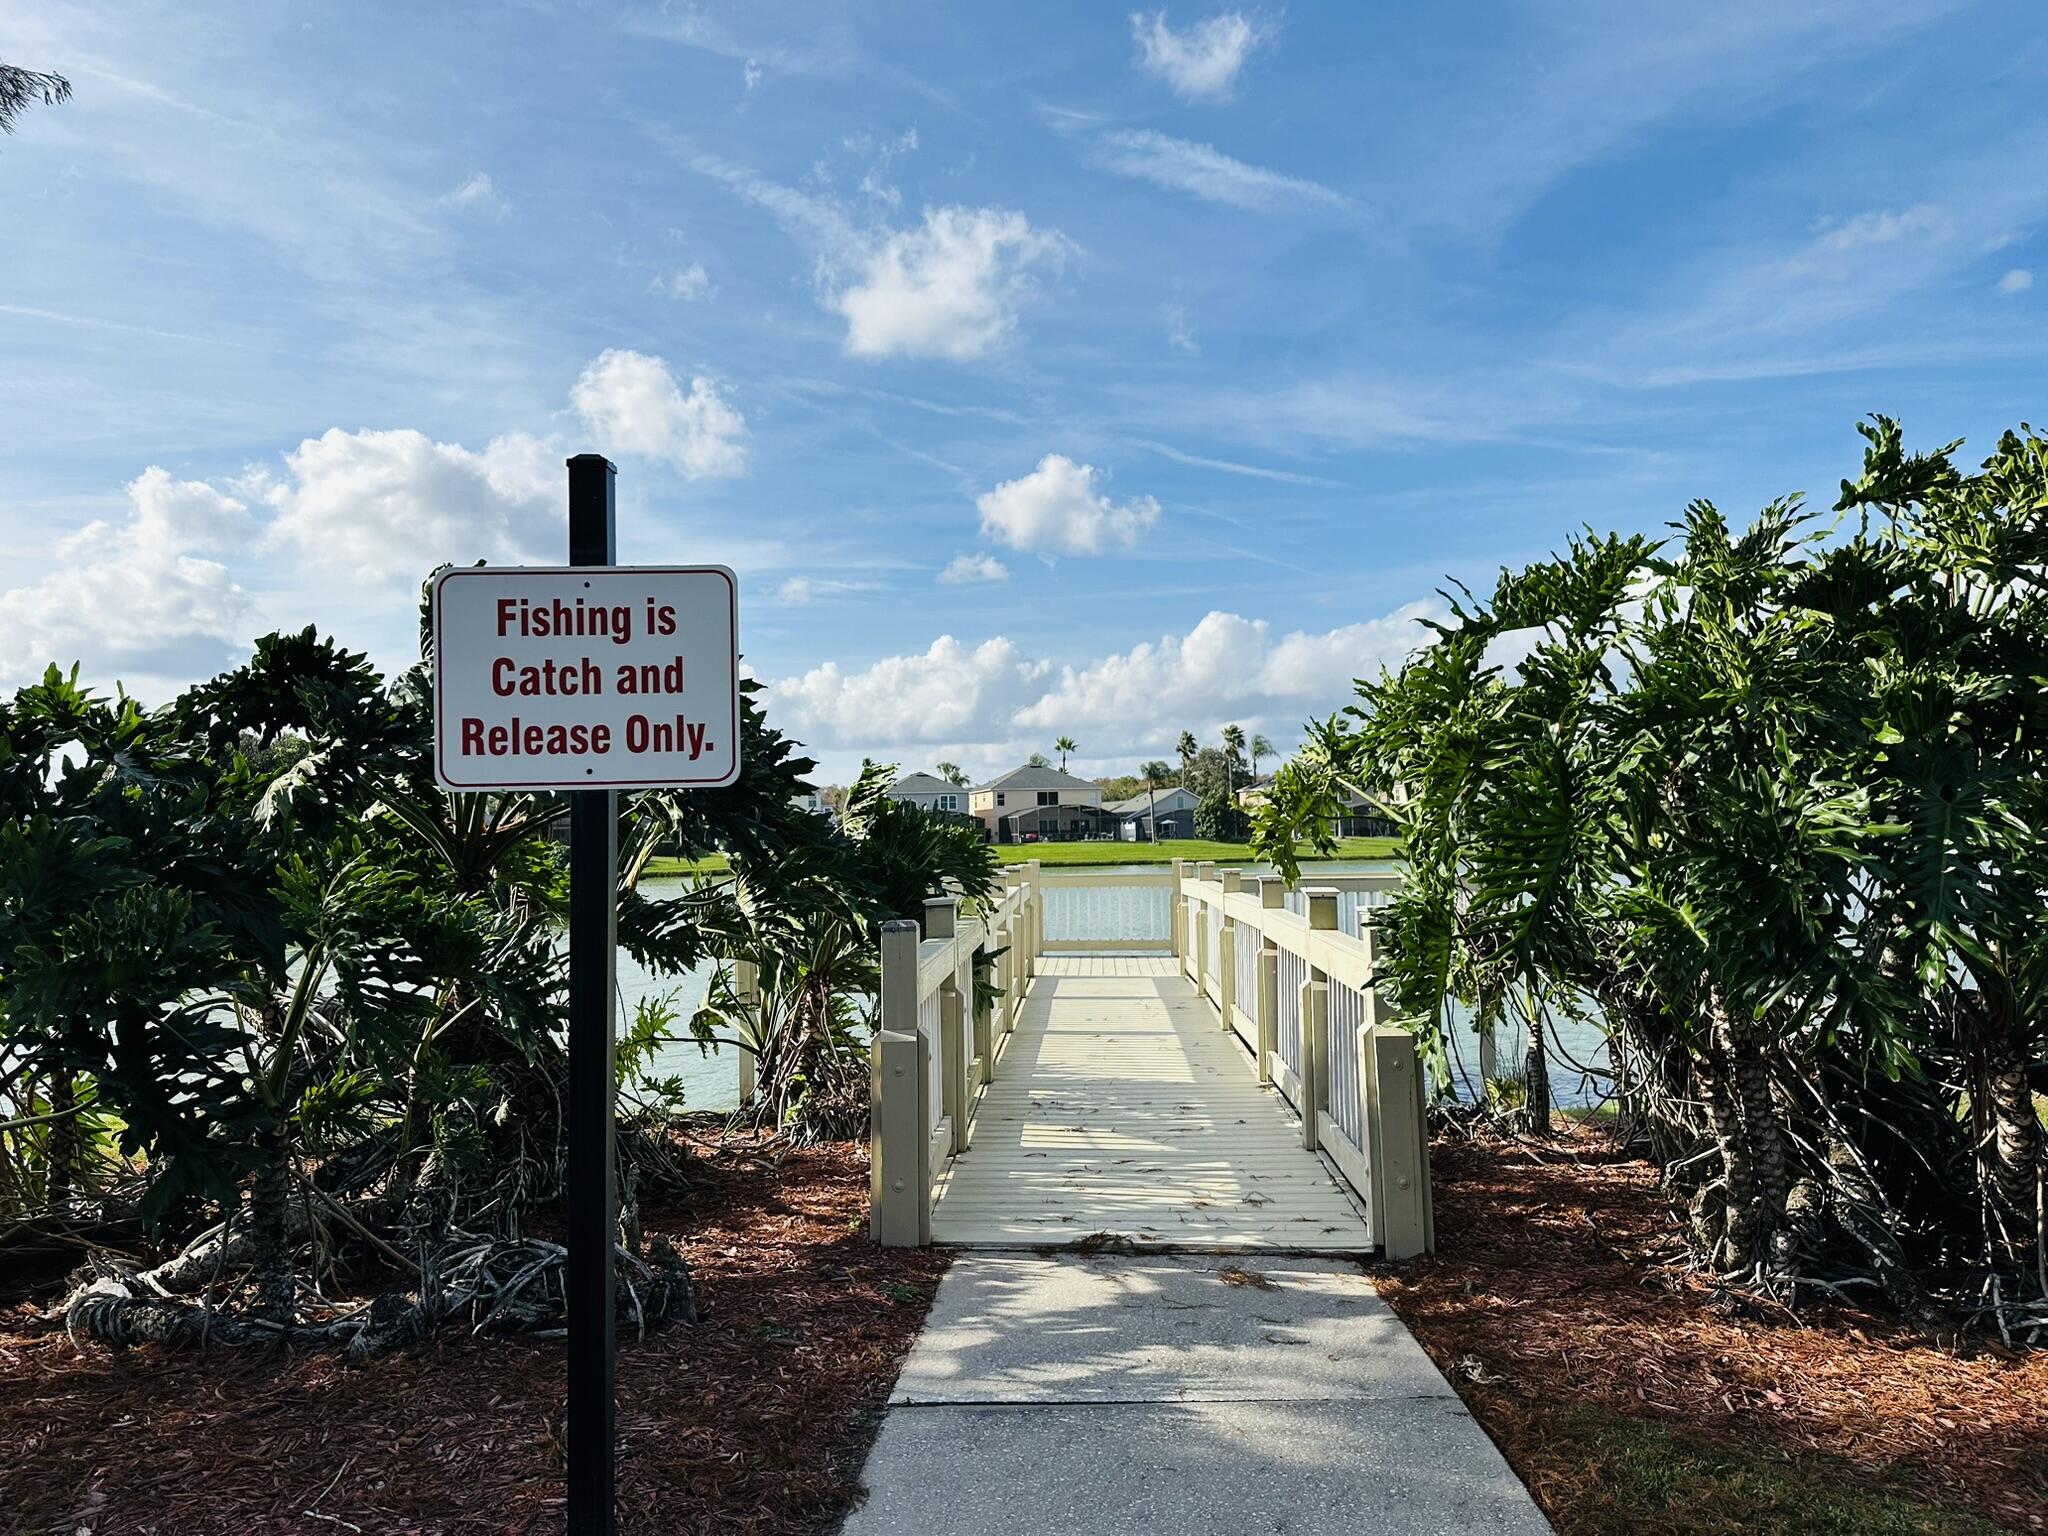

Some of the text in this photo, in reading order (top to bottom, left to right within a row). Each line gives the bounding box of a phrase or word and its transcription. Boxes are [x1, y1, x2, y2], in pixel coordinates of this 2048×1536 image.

[497, 597, 677, 644] Fishing is
[492, 656, 684, 697] Catch and
[462, 714, 715, 761] Release Only.
